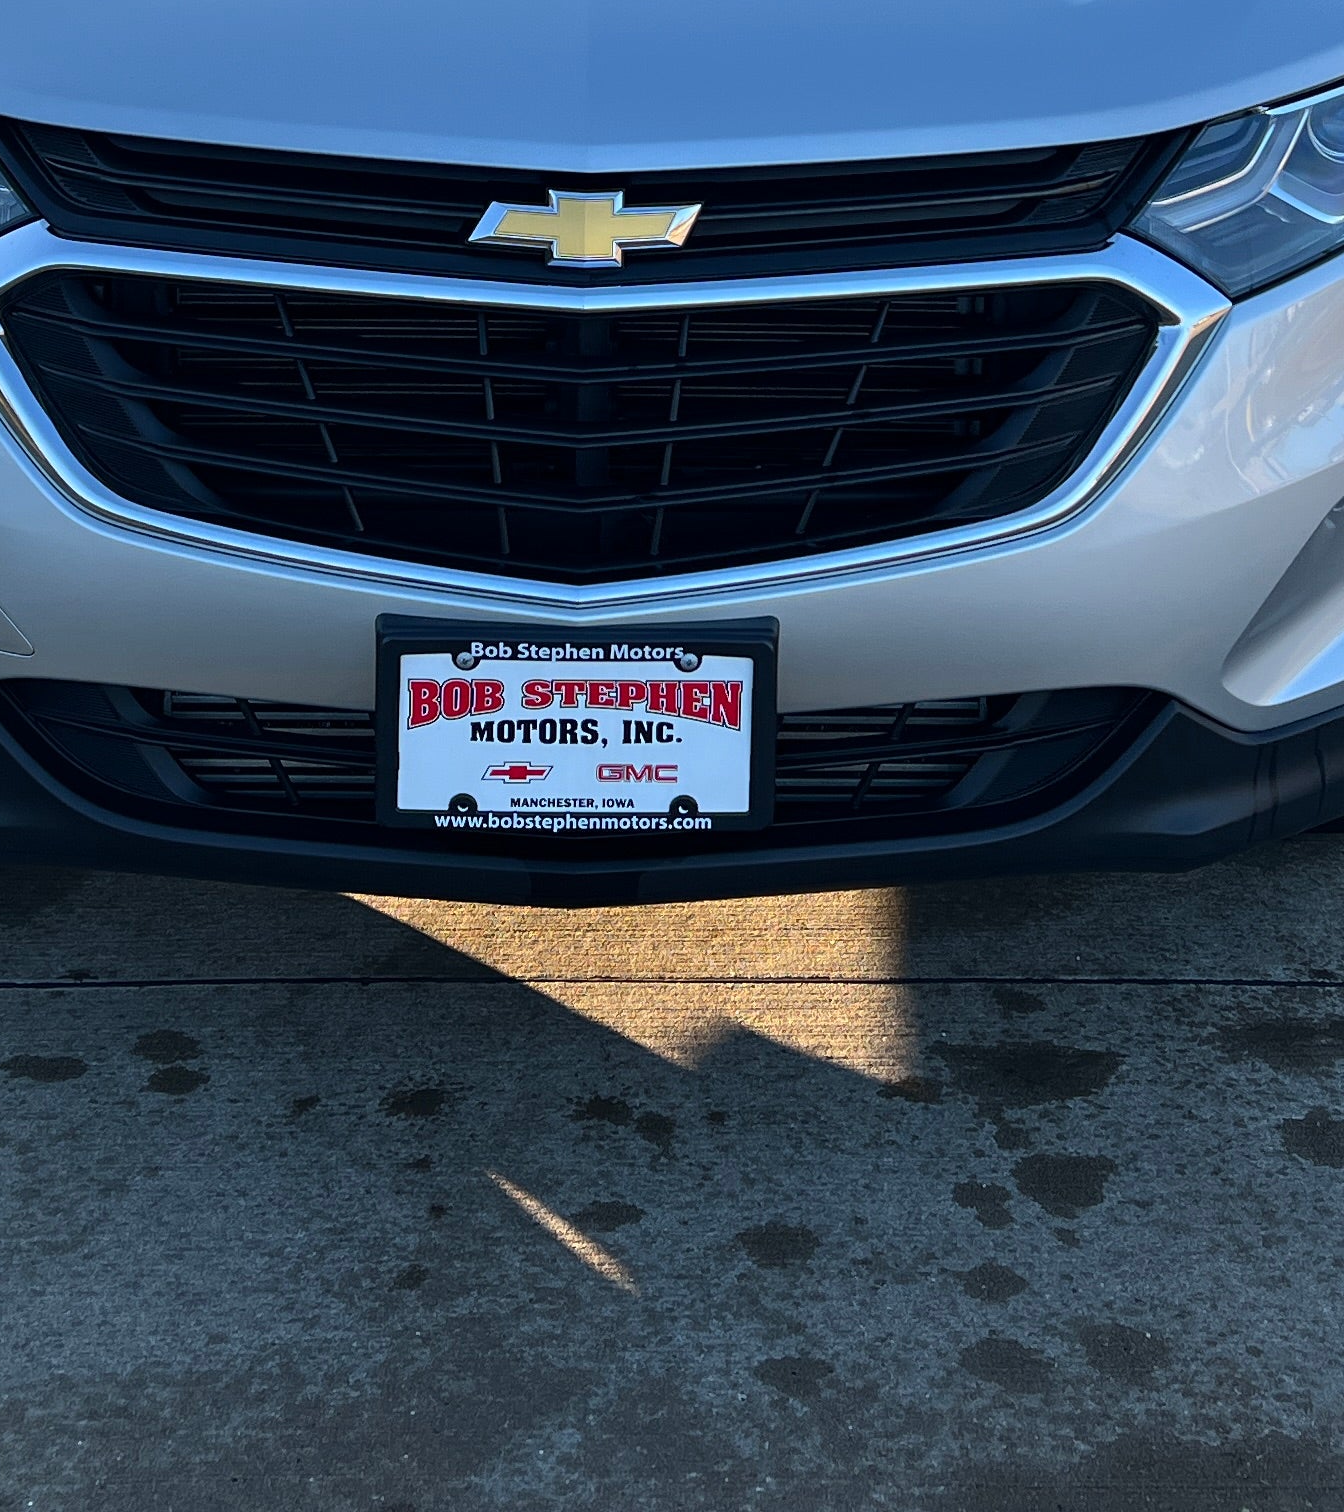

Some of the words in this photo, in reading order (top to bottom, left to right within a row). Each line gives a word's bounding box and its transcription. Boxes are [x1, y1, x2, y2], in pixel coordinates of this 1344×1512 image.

[471, 642, 512, 658] Bob
[517, 643, 604, 662] Stephen
[610, 644, 684, 660] Motors
[407, 678, 505, 730] BOB
[521, 679, 743, 731] STEPHEN
[470, 718, 608, 748] MOTORS,
[622, 719, 683, 745] INC.
[595, 763, 678, 784] GMC
[510, 798, 599, 810] MANCHESTER,
[602, 799, 635, 809] IOWA
[434, 813, 712, 832] www.bobstephenmotors.com
